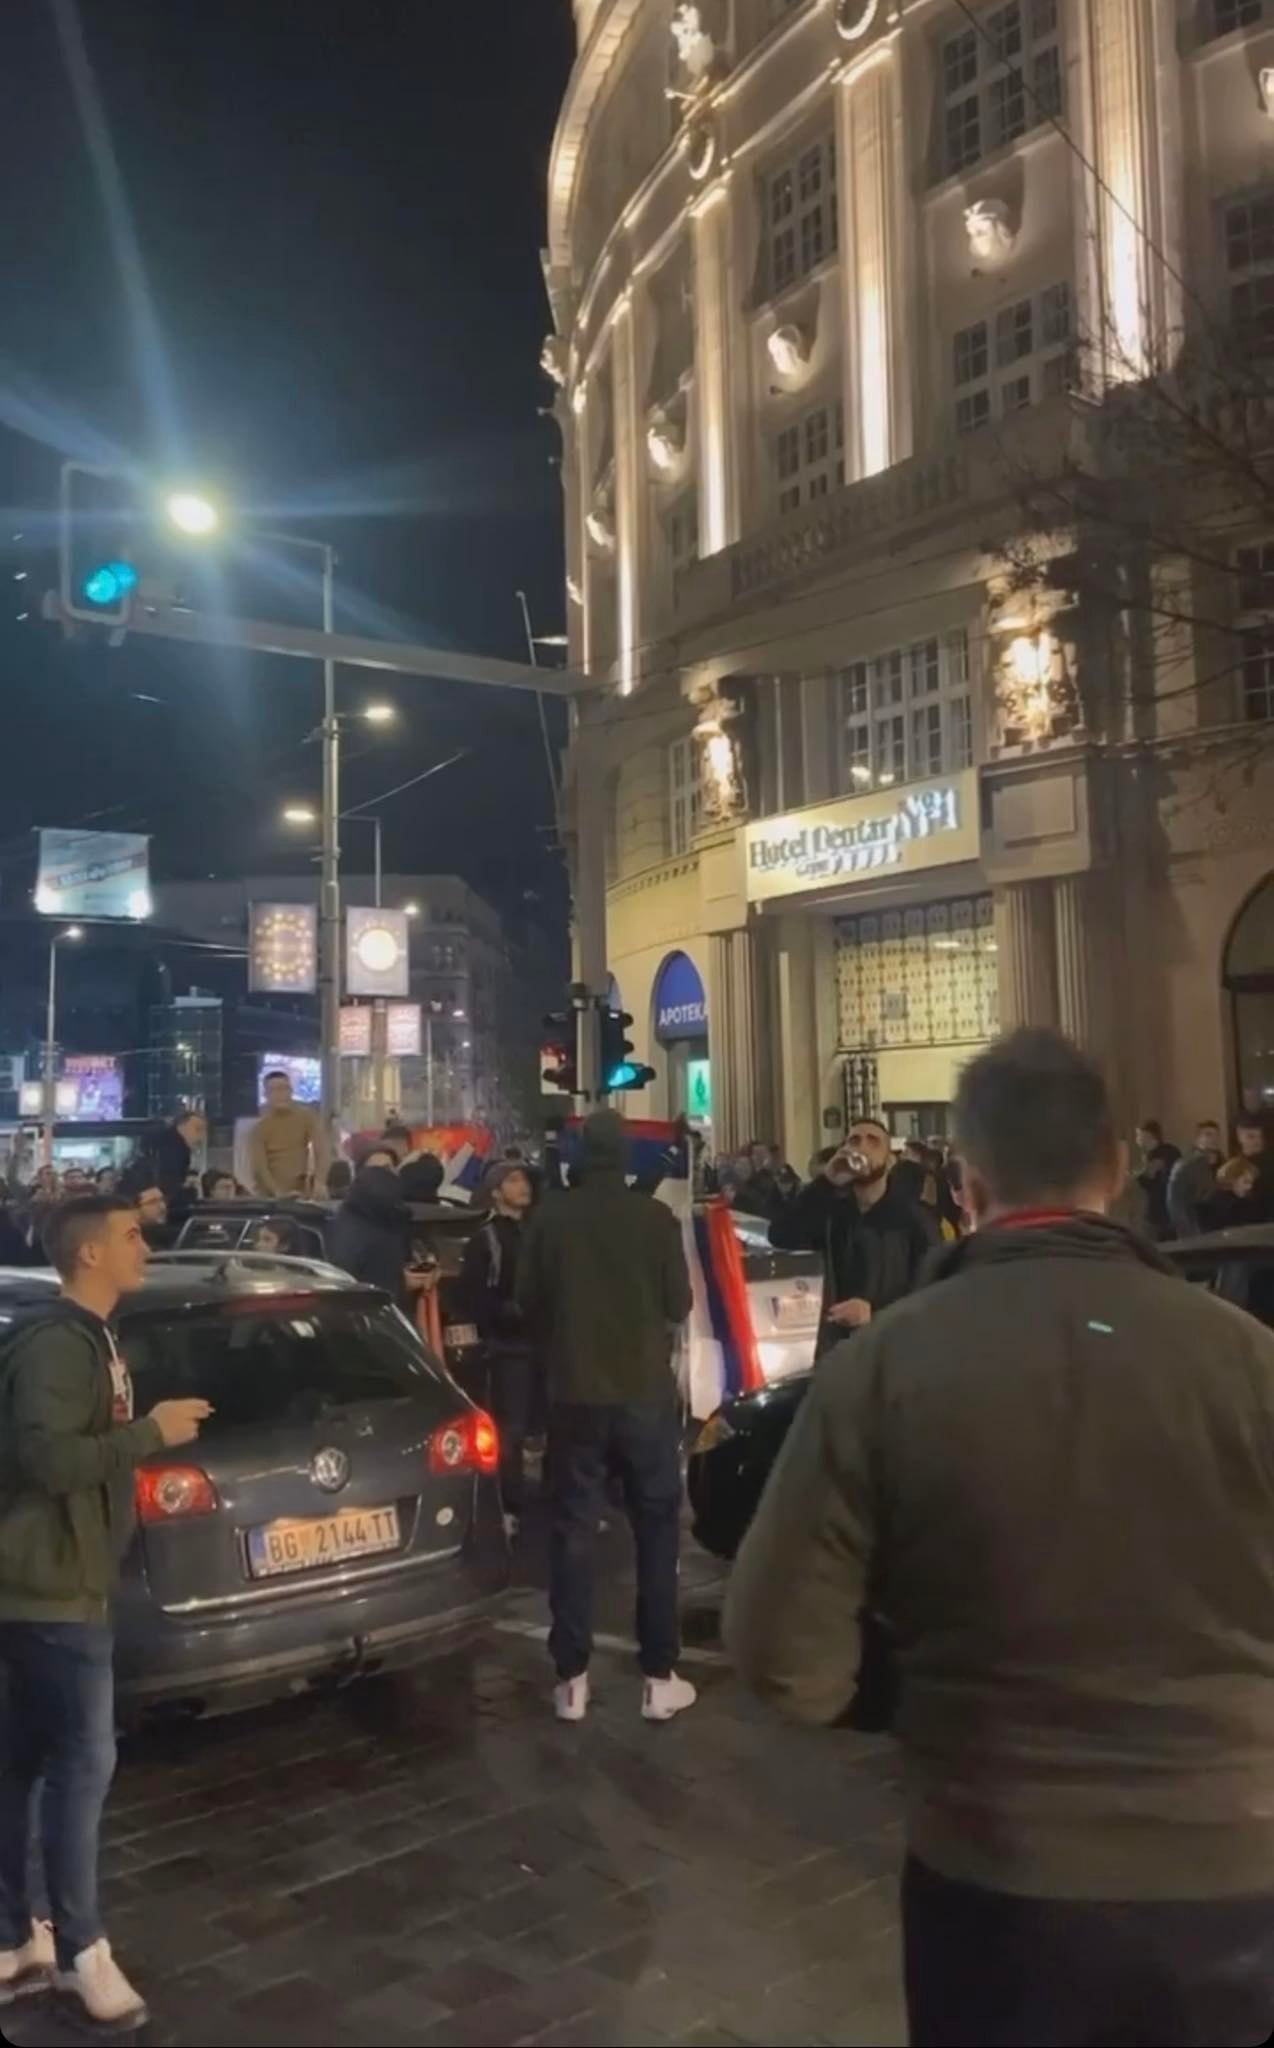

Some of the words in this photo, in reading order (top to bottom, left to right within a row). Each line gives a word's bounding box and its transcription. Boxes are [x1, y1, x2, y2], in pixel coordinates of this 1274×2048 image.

[750, 829, 807, 868] Hotel
[658, 1003, 704, 1026] APOTEK
[268, 1533, 298, 1563] BG
[315, 1519, 367, 1552] 2144
[371, 1511, 395, 1539] TT
